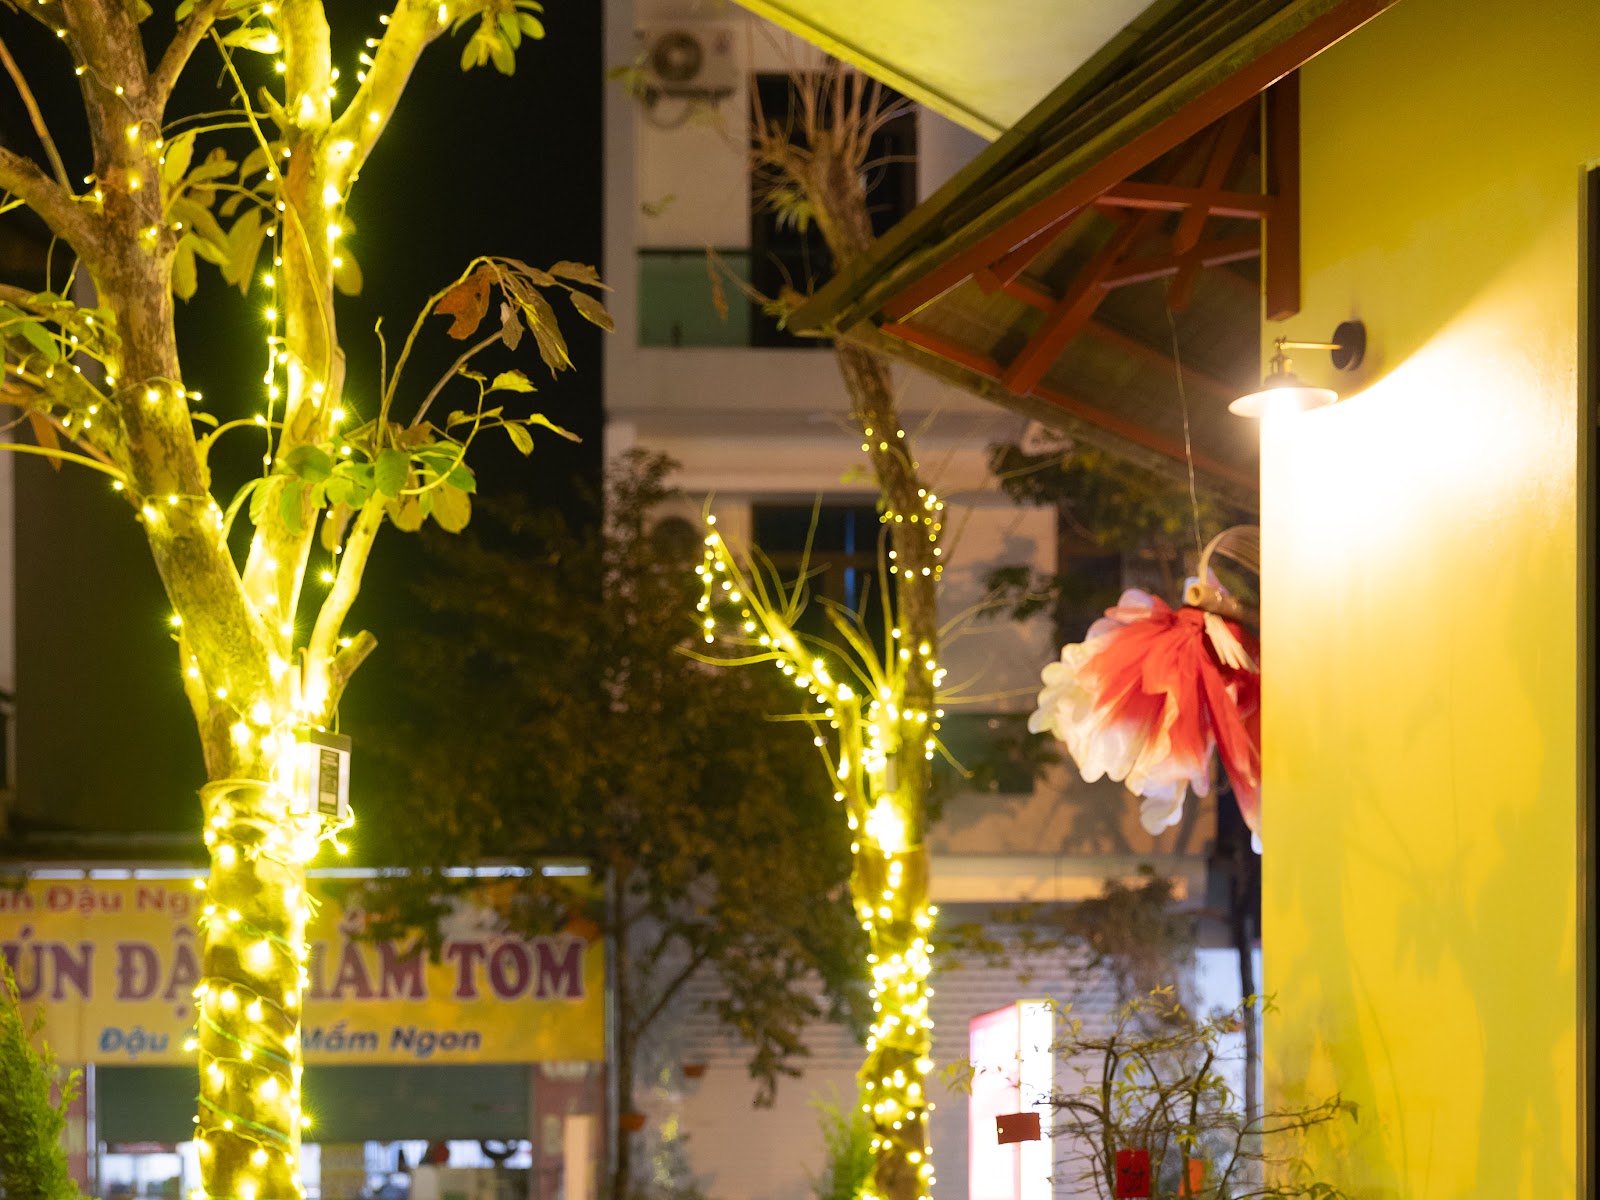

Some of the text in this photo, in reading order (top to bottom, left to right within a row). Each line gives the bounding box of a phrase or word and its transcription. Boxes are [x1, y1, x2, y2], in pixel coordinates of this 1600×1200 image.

[137, 886, 200, 920] Ng
[115, 925, 203, 1019] ĐẬ
[391, 1026, 482, 1058] Ngon
